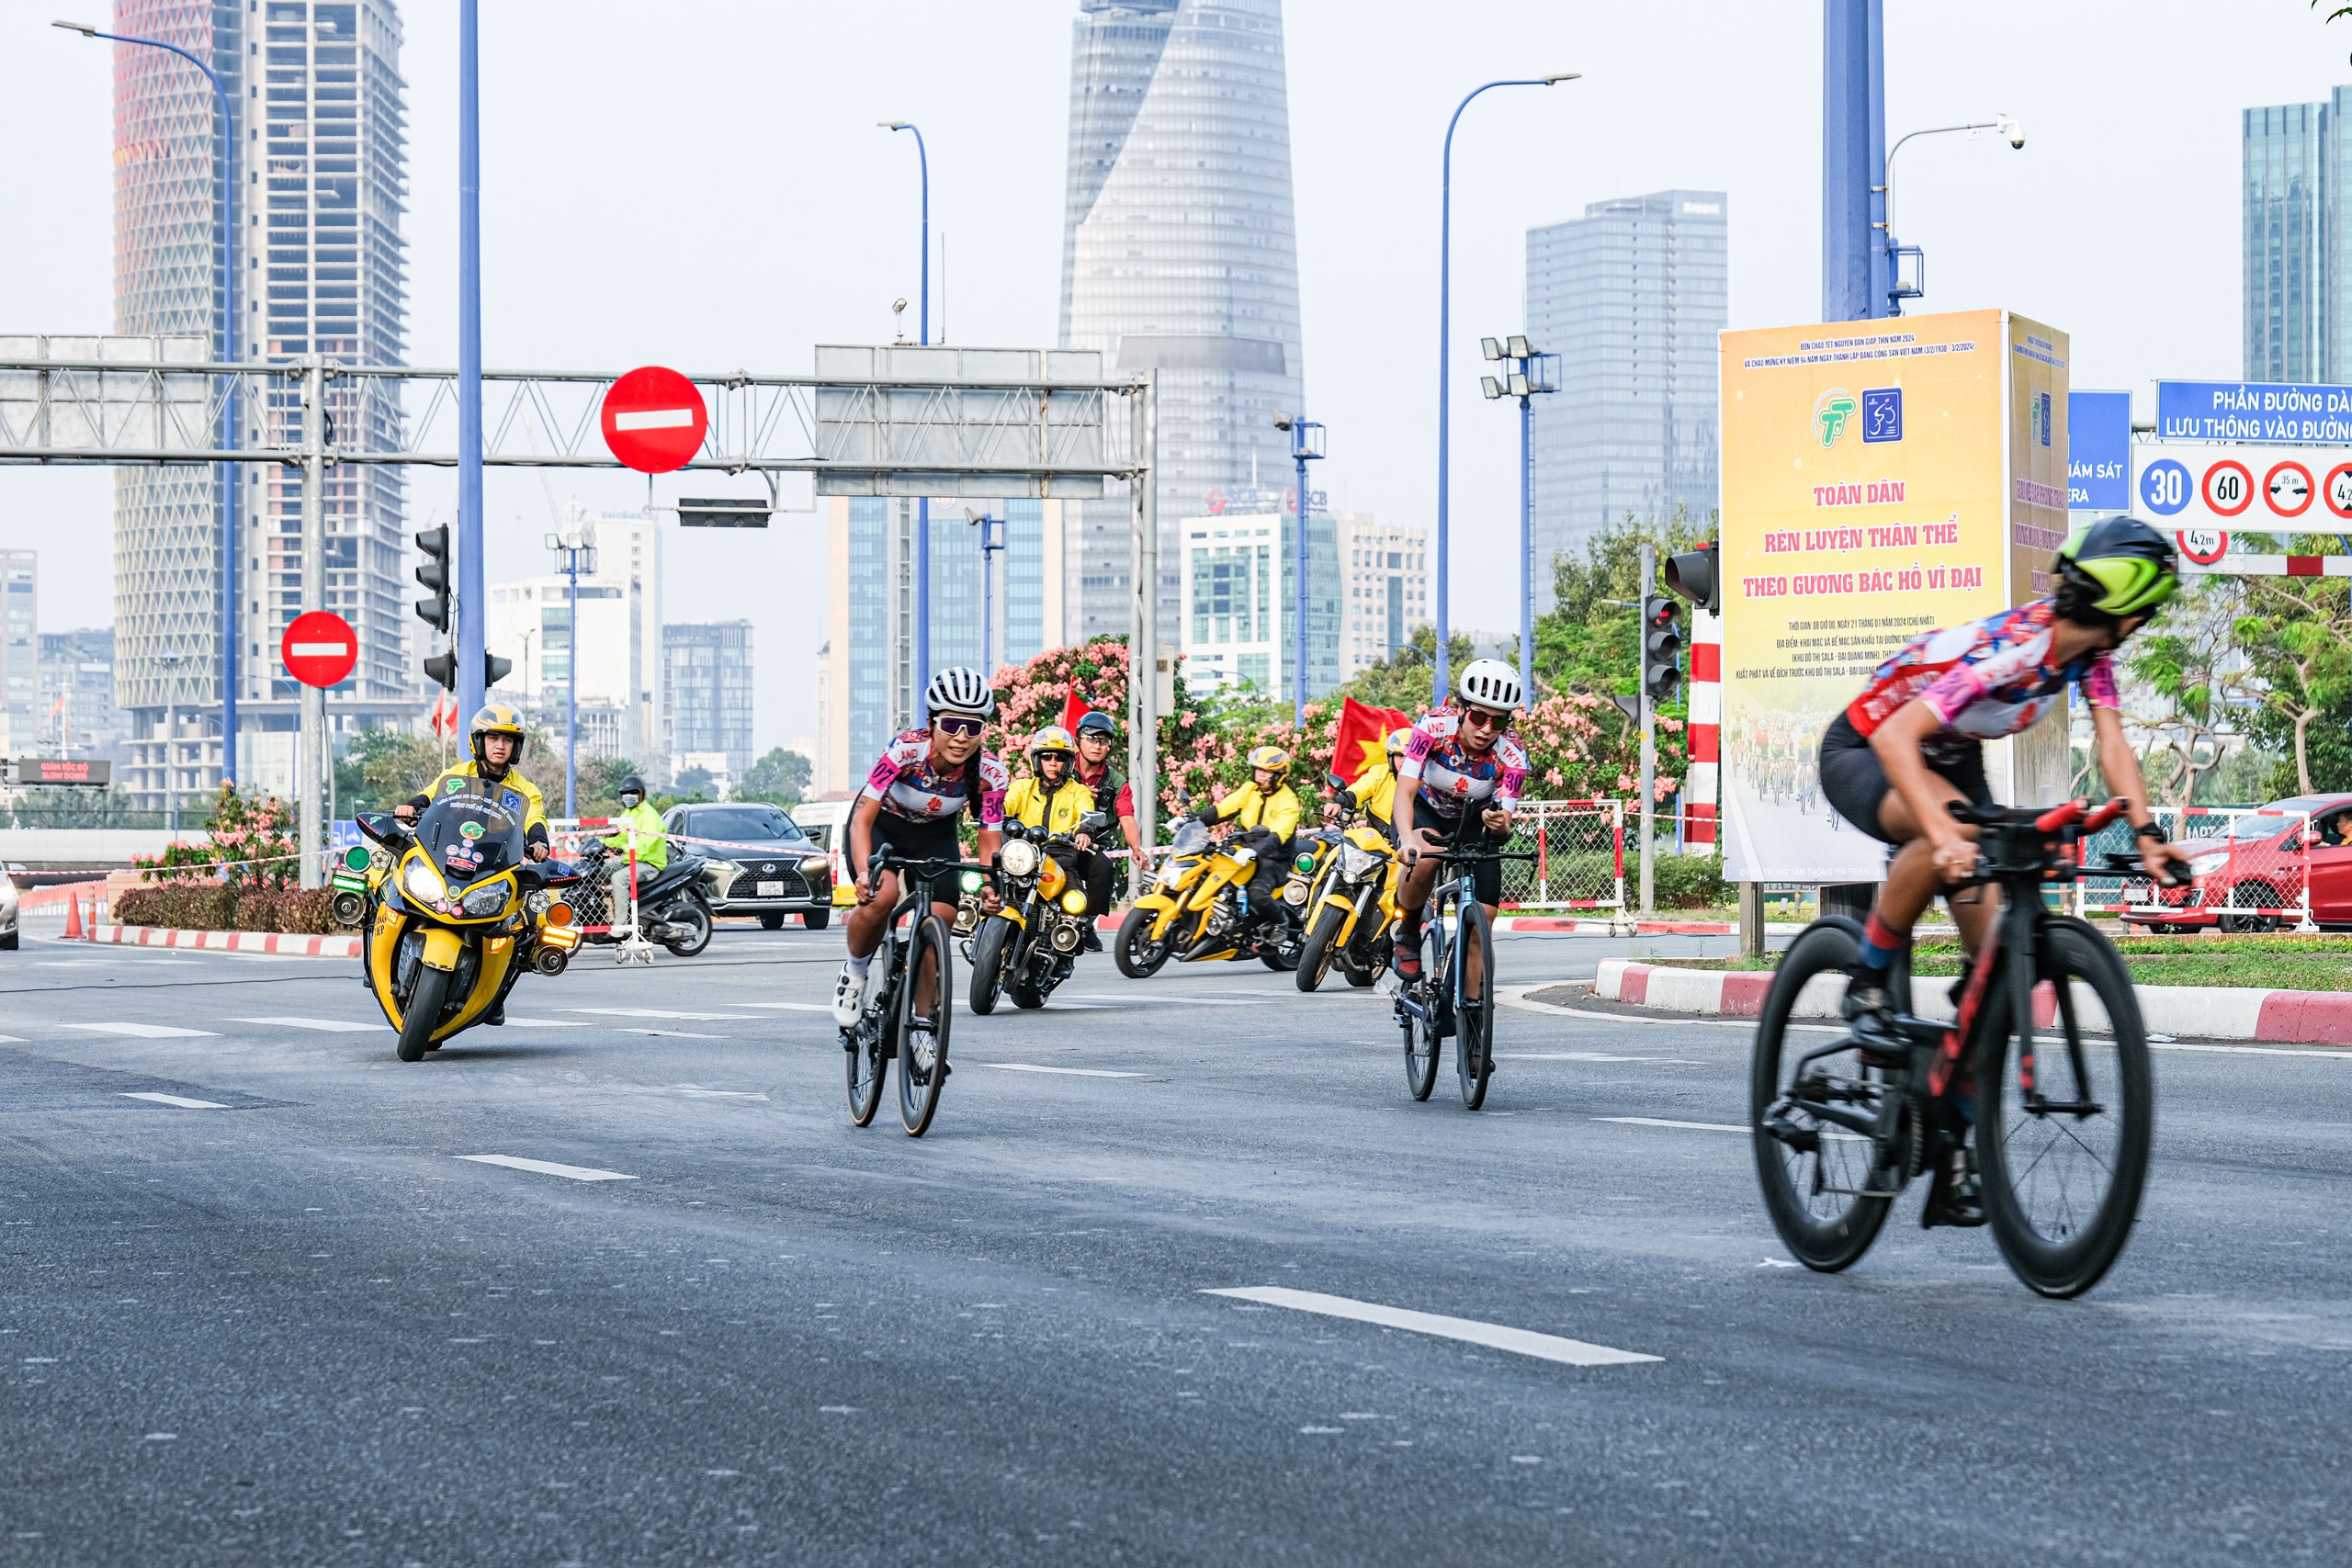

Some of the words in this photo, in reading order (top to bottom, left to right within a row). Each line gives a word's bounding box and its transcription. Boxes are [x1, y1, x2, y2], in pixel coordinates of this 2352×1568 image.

[1902, 333, 1915, 343] 2024
[2213, 384, 2260, 411] PHẦN
[2264, 387, 2323, 412] ĐƯỜNG
[2327, 389, 2352, 413] DÀ
[2166, 416, 2200, 437] LƯU
[2204, 414, 2260, 438] THÔNG
[2265, 415, 2298, 439] VÀO
[2302, 415, 2352, 440] ĐƯỜN
[2096, 461, 2123, 478] SÁT
[2151, 468, 2183, 506] 30
[2217, 476, 2239, 500] 60
[2282, 475, 2290, 485] 35
[1814, 481, 1861, 507] TOÀN
[1867, 479, 1905, 503] DÂN
[1765, 529, 1800, 553] RÈN
[1805, 525, 1863, 553] LUYỆN
[1868, 522, 1917, 547] THÂN
[1922, 513, 1958, 545] THỂ
[2190, 530, 2215, 546] 4.2m
[1743, 576, 1787, 598] THEO
[1793, 573, 1854, 595] GƯƠNG
[1859, 568, 1893, 592] BÁC
[1898, 562, 1922, 591] HỒ
[1927, 564, 1945, 589] VĨ
[1951, 567, 1982, 592] ĐẠI
[1813, 620, 1820, 630] 08
[1851, 619, 1858, 628] 21
[1894, 617, 1906, 627] 2024
[1800, 638, 1811, 647] KHAI
[1821, 652, 1834, 662] SALA
[1847, 651, 1864, 661] QUANG
[1805, 667, 1815, 677] KHU
[1832, 666, 1845, 676] SALA
[41, 772, 63, 780] SLOW
[64, 772, 88, 780] DOWN
